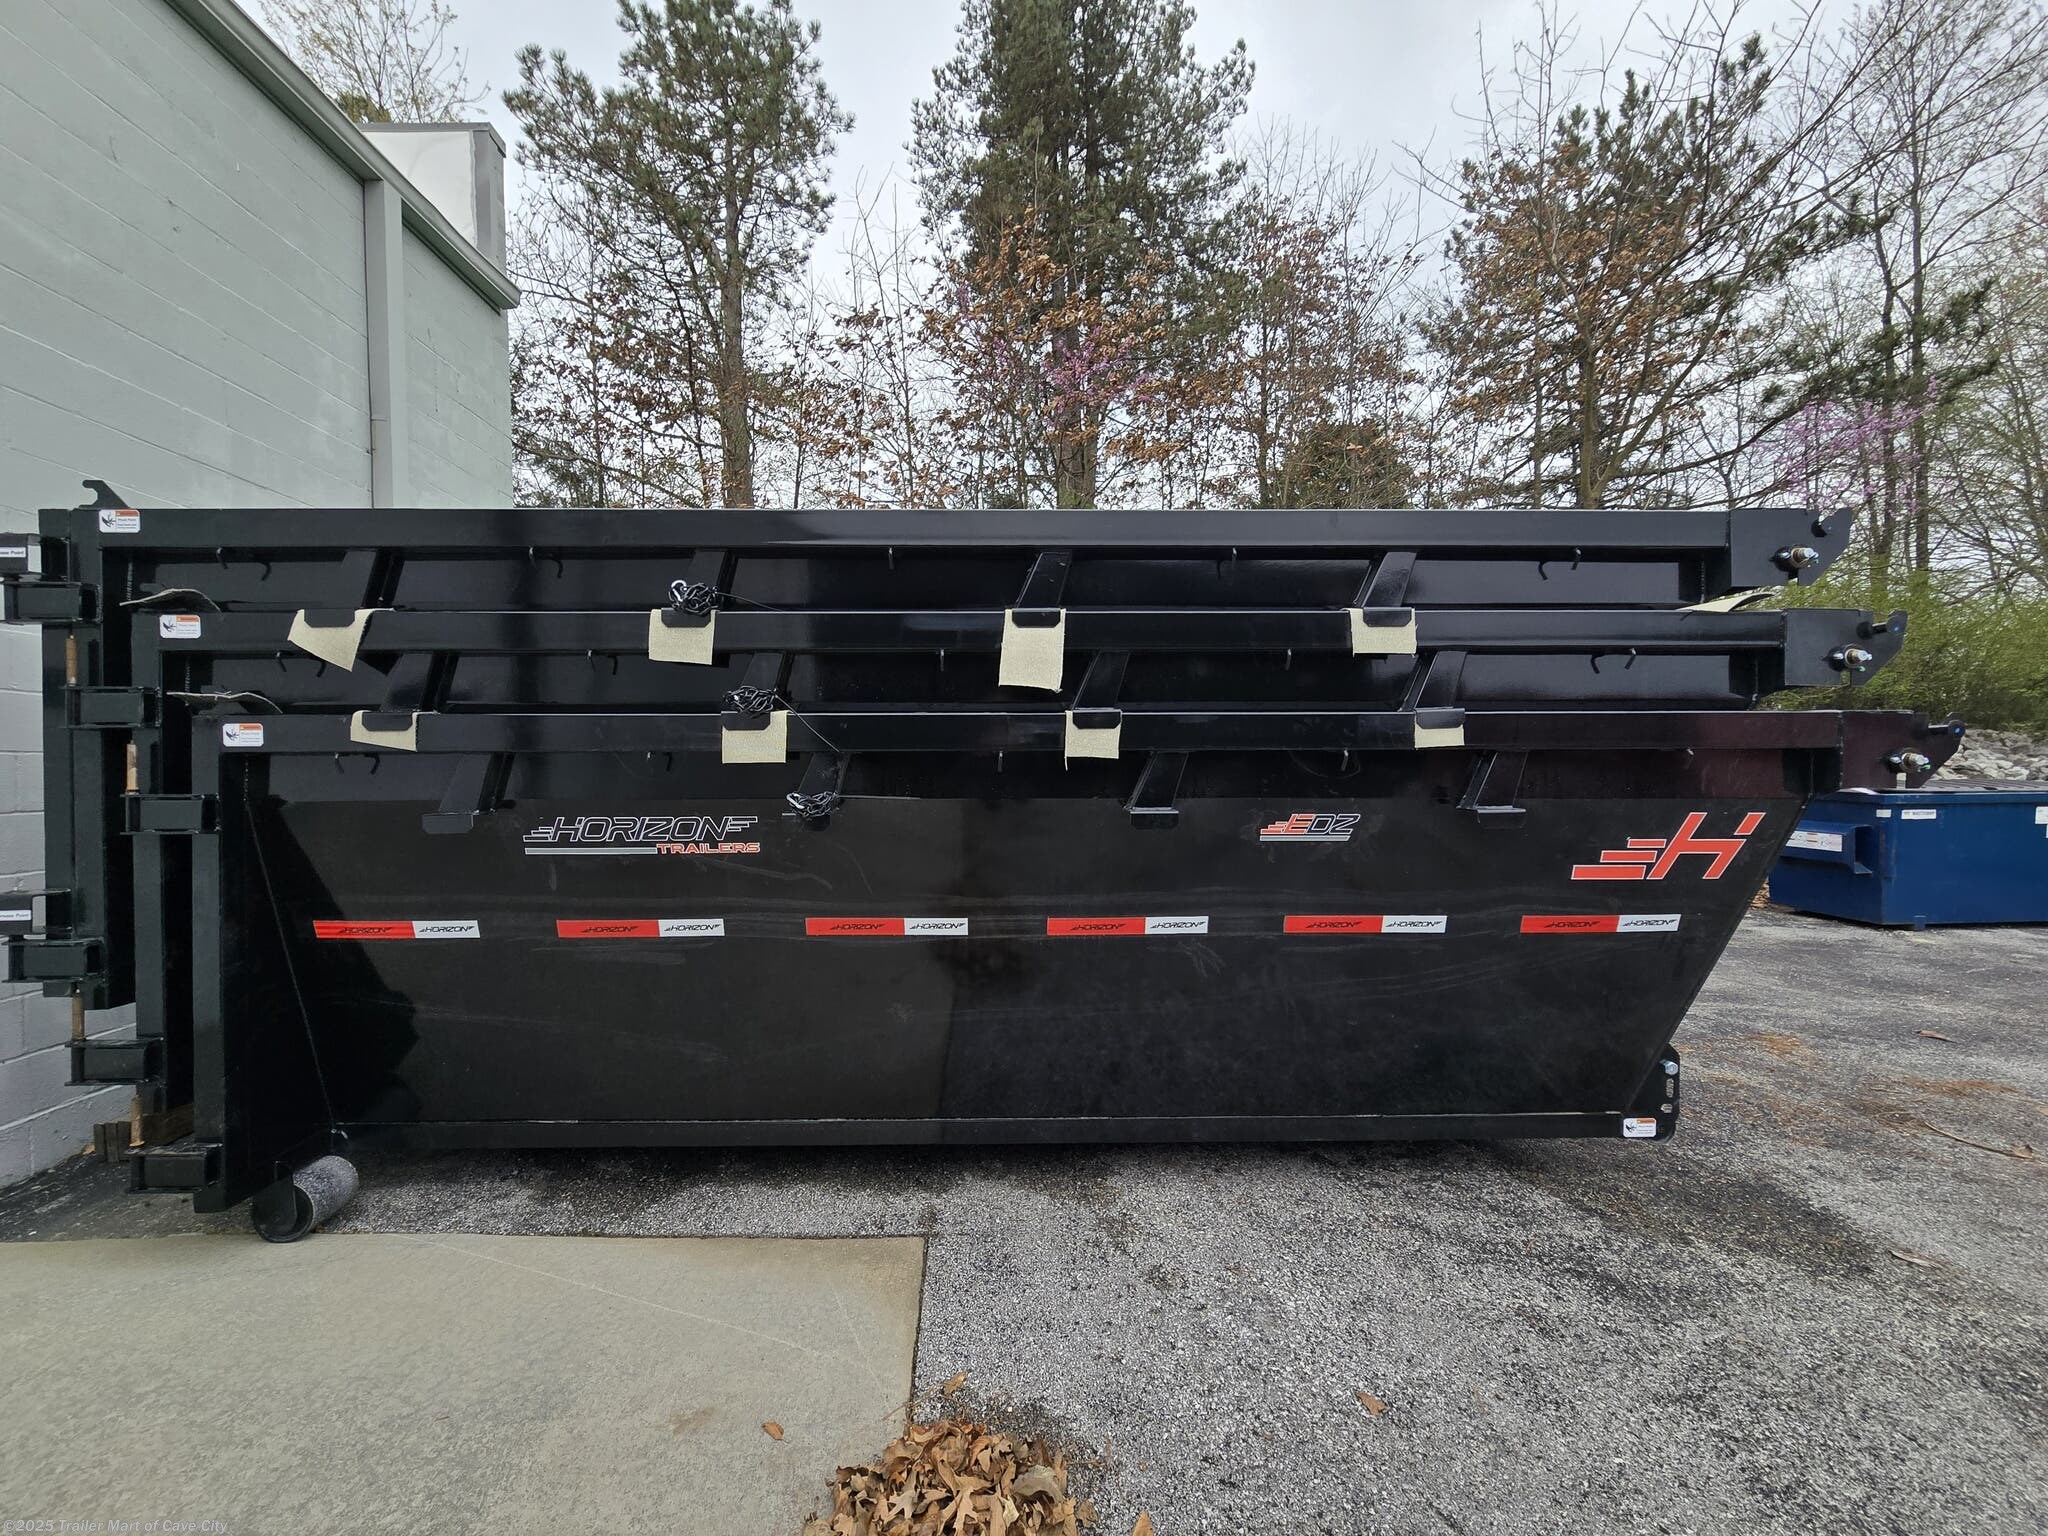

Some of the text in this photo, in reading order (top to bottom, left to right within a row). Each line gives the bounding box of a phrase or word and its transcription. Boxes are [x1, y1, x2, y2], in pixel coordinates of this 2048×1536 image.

[546, 816, 732, 842] HORIZON
[656, 843, 761, 854] TRAILERS
[835, 922, 960, 931] HORIZON HORIZON
[1076, 921, 1200, 931] HORIZON HORIZON
[1391, 920, 1436, 928] HORIZON
[1549, 919, 1670, 928] HORIZON HORIZON
[342, 925, 470, 934] HORIZON HORIZON
[587, 924, 715, 933] HORIZON HORIZON
